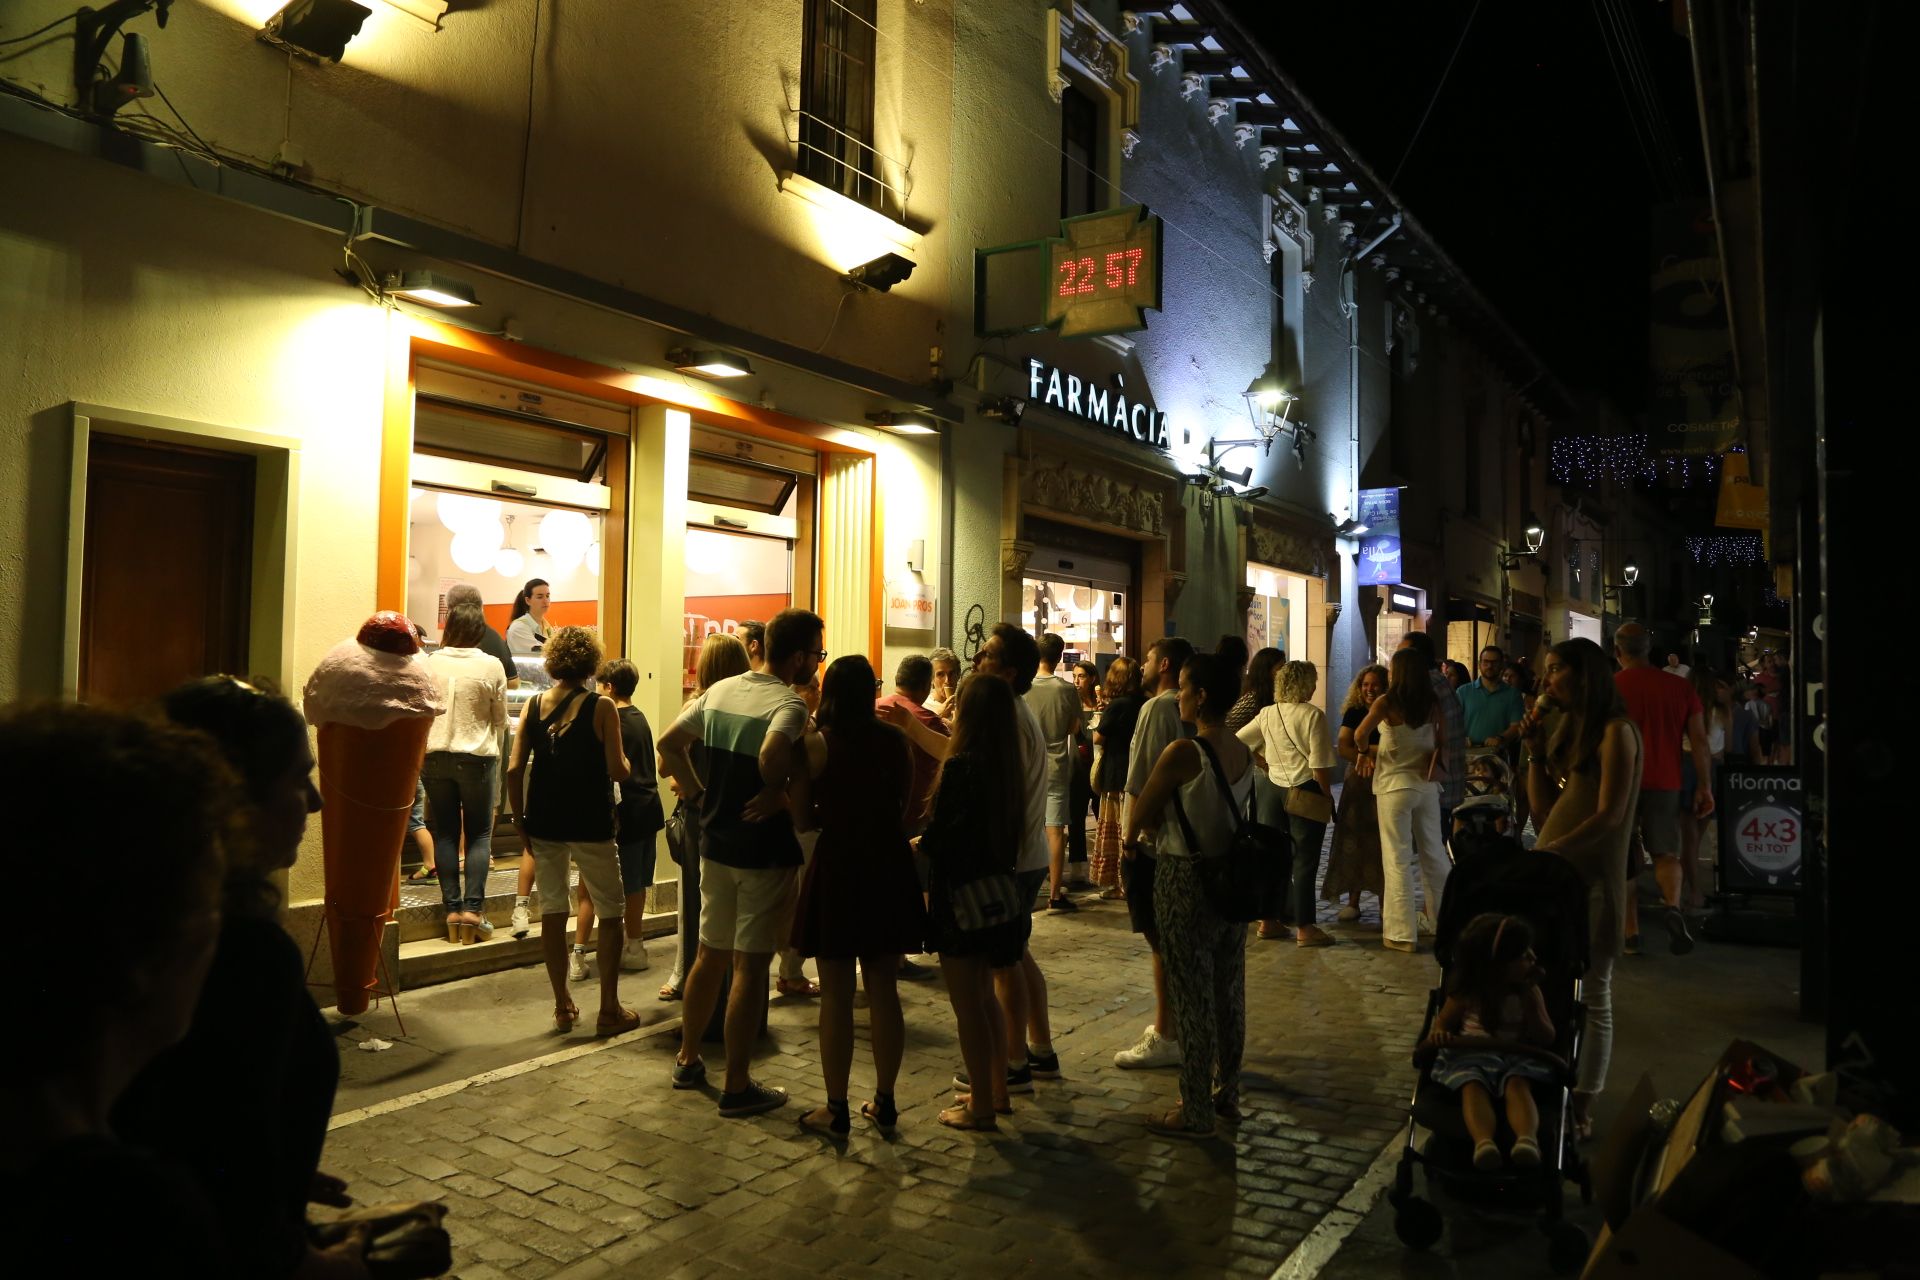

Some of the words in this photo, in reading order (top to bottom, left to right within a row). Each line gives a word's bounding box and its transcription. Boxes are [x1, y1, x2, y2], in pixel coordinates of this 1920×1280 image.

[1059, 257, 1096, 296] 22
[1105, 248, 1143, 289] 57
[1029, 358, 1171, 448] FARMÀCIA
[913, 599, 932, 612] PROS
[1746, 844, 1763, 852] EN
[1768, 844, 1792, 853] TOT
